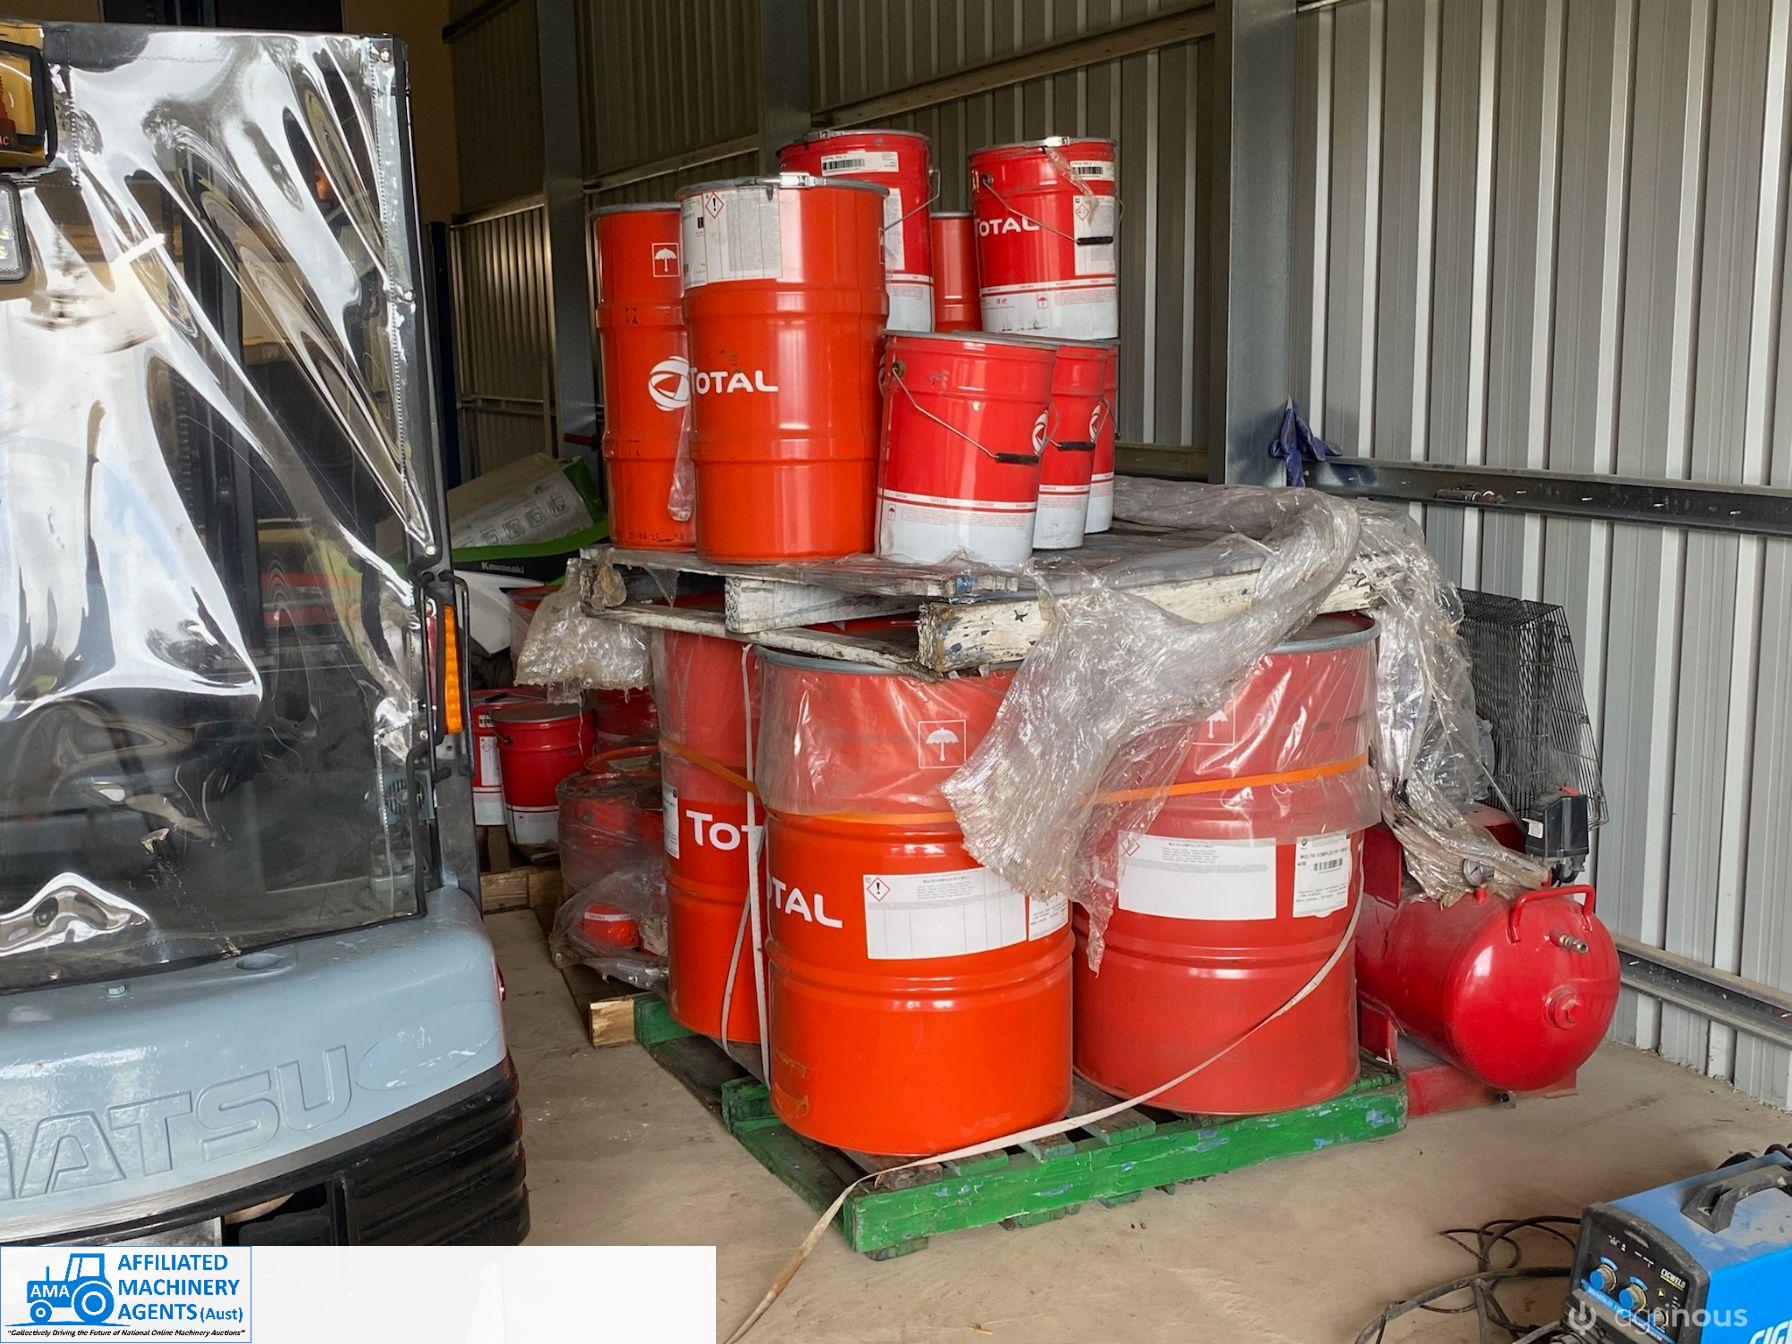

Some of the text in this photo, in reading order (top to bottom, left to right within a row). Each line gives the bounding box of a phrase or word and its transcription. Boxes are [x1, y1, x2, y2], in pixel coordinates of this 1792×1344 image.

[690, 368, 779, 395] TOTAL
[686, 809, 764, 851] TOT
[771, 876, 843, 929] TAL
[0, 1045, 352, 1200] ATSU
